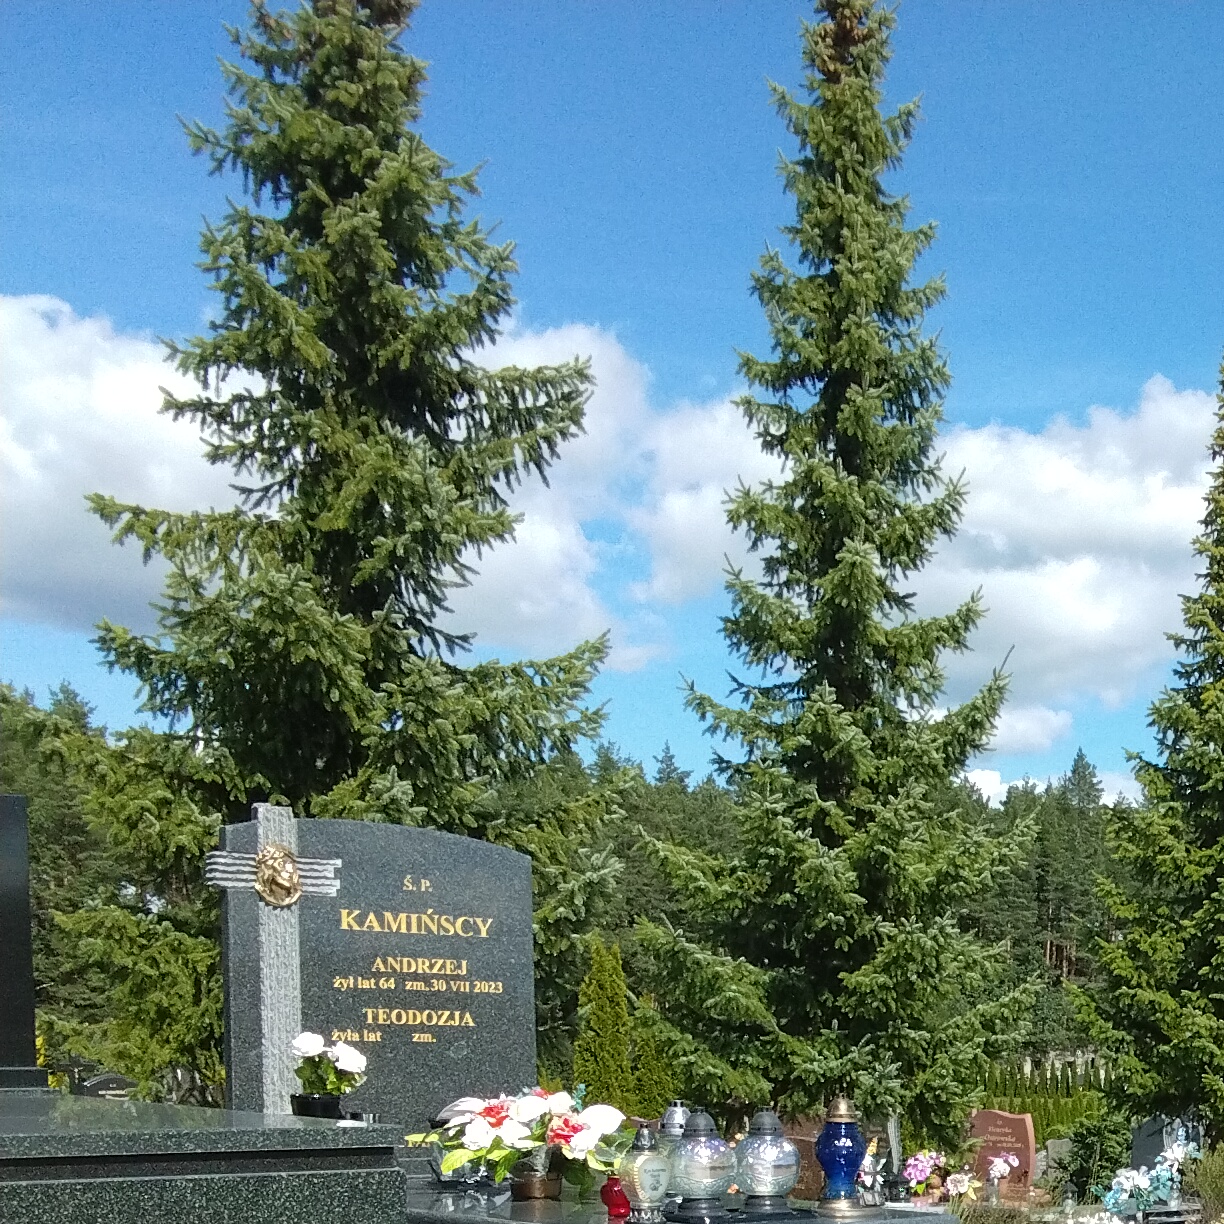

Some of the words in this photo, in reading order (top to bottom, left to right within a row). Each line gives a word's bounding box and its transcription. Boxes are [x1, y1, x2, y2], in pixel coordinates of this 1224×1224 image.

[339, 908, 493, 938] KAMIŃSCY
[371, 956, 468, 975] ANDRZEJ
[357, 977, 376, 989] lat
[378, 977, 396, 990] 64
[450, 981, 470, 992] VII
[473, 981, 503, 994] 2023
[363, 1008, 476, 1027] TEODOZJA
[363, 1029, 382, 1042] lat
[411, 1033, 437, 1043] zm.
